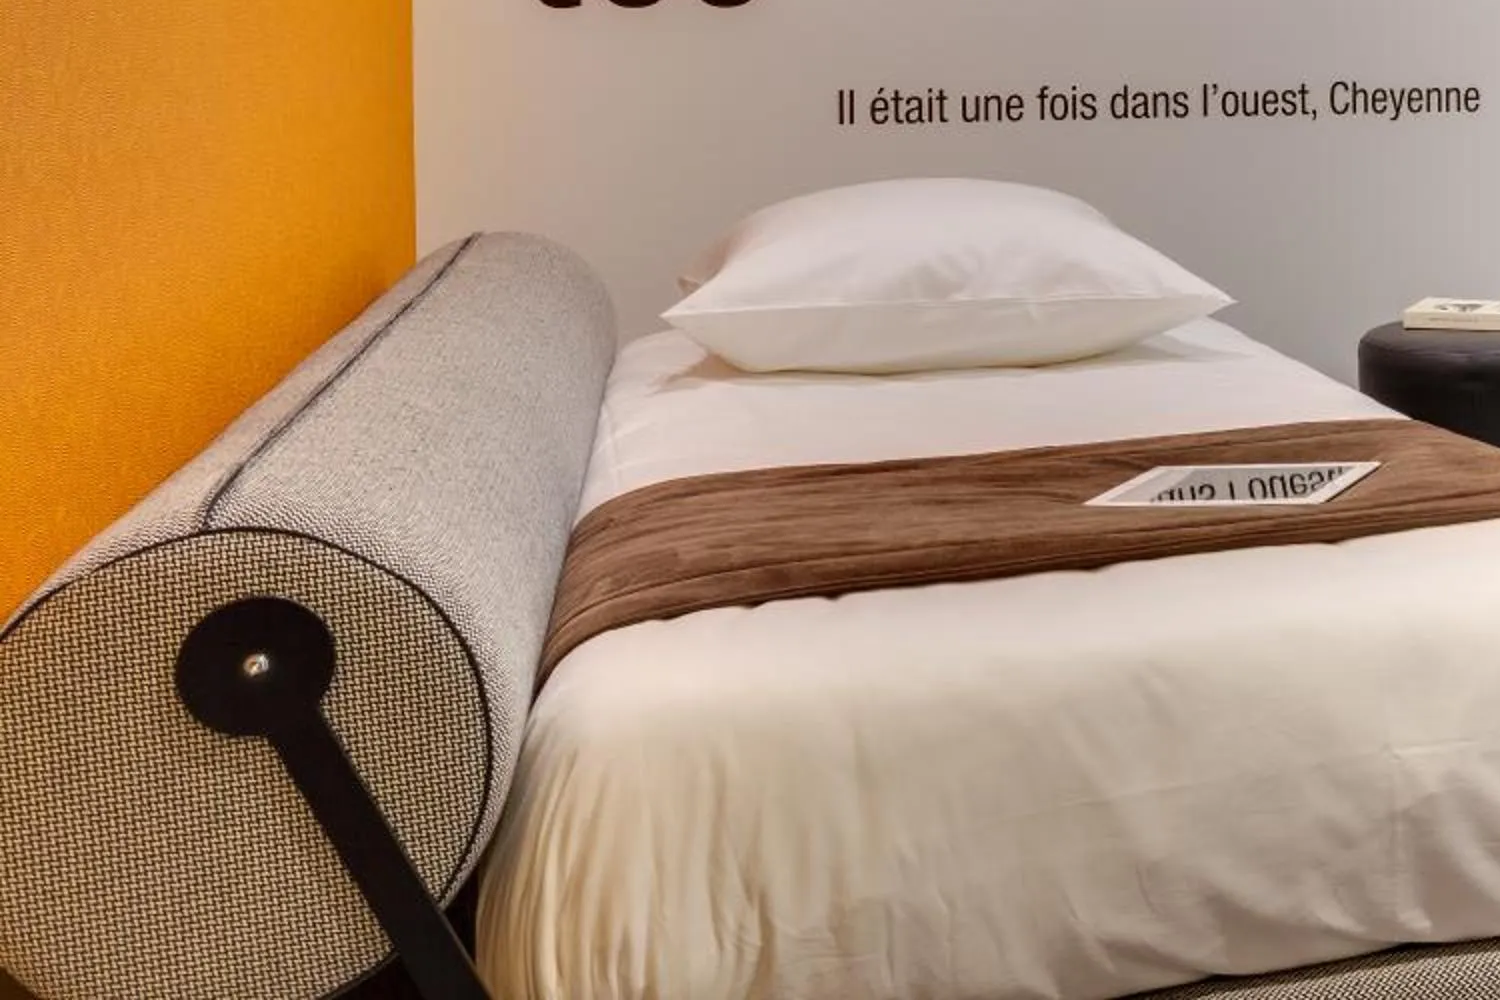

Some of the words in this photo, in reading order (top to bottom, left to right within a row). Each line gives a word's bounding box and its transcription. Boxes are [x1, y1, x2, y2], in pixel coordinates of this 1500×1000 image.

[838, 89, 855, 126] Il
[869, 87, 949, 125] était
[961, 93, 1025, 123] une
[1035, 84, 1098, 122] fois
[1109, 84, 1190, 120] dans
[1329, 80, 1480, 121] Cheyenne
